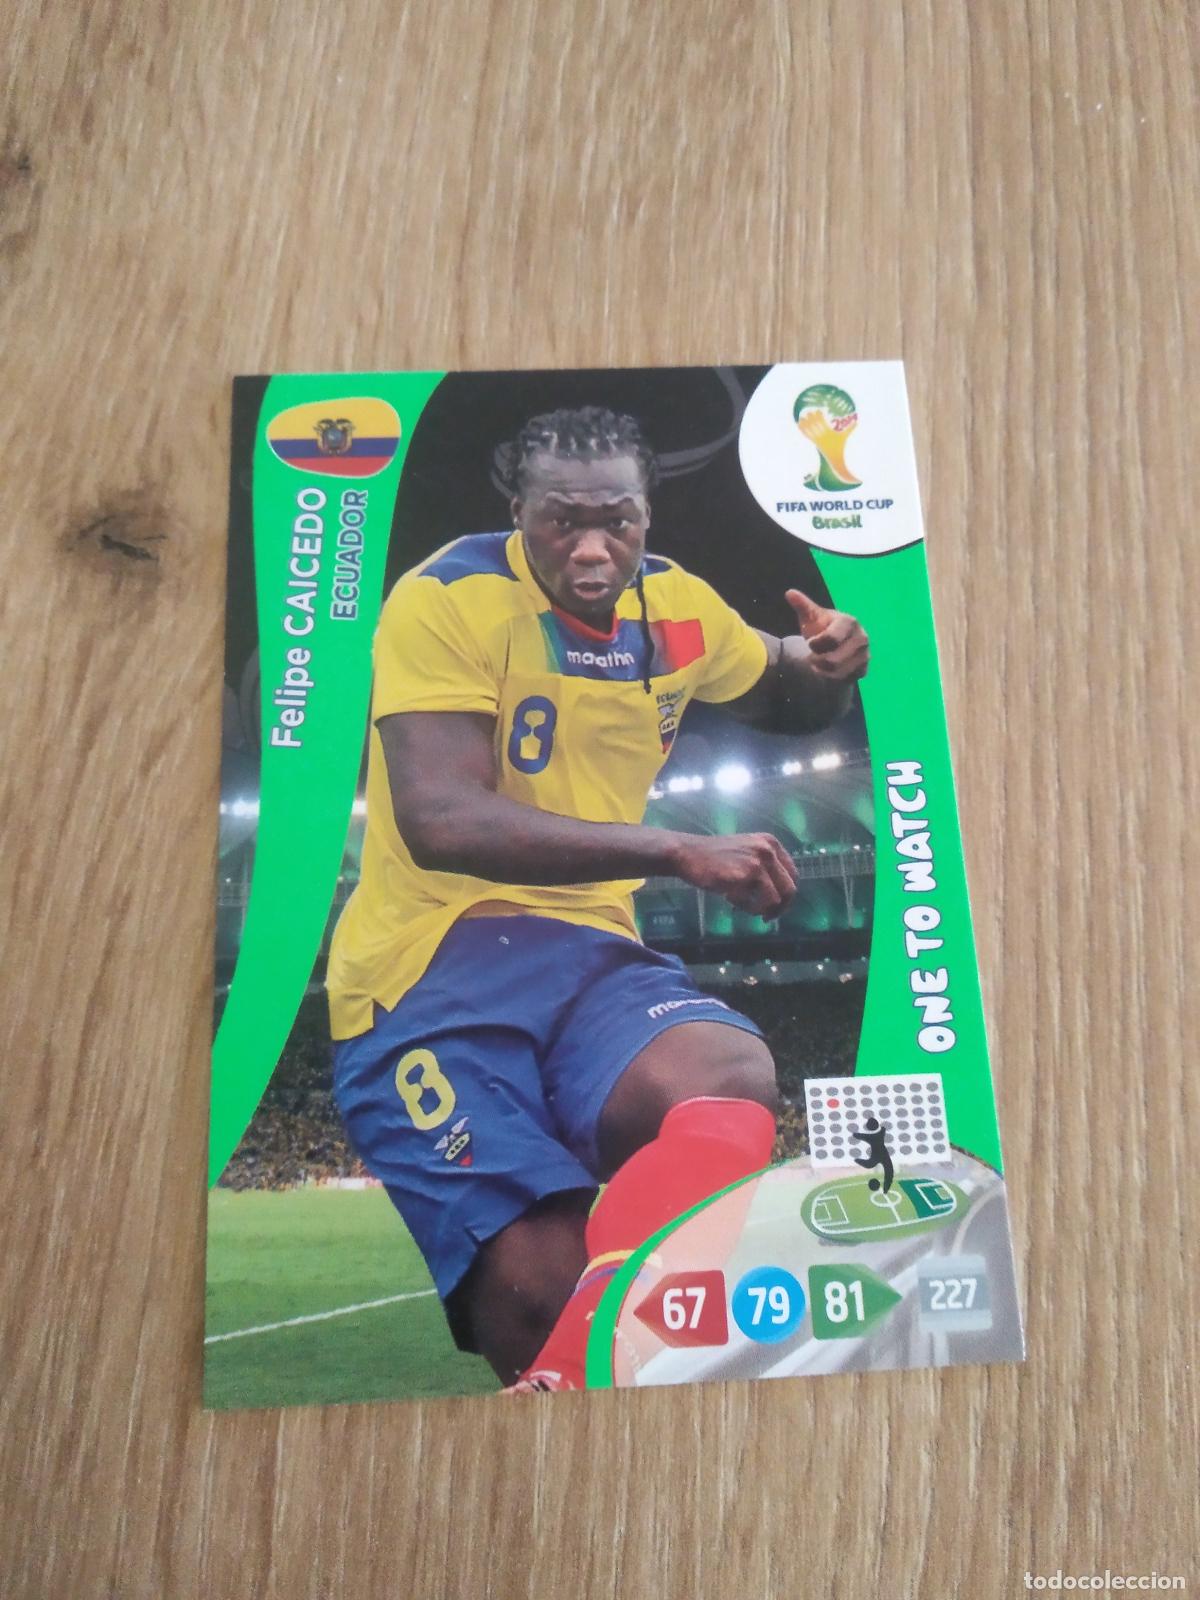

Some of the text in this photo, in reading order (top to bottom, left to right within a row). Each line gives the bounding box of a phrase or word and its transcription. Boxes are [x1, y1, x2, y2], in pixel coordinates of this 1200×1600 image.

[776, 499, 894, 513] FIFA WORLD CUP
[812, 514, 863, 530] Brasil
[330, 488, 369, 620] ECUADOR
[270, 487, 328, 749] Felipe CAICEDO
[507, 695, 558, 775] 8
[885, 760, 957, 1055] ONE TO WATCH
[395, 1048, 457, 1131] 8
[661, 1278, 979, 1331] 67 79 81 227
